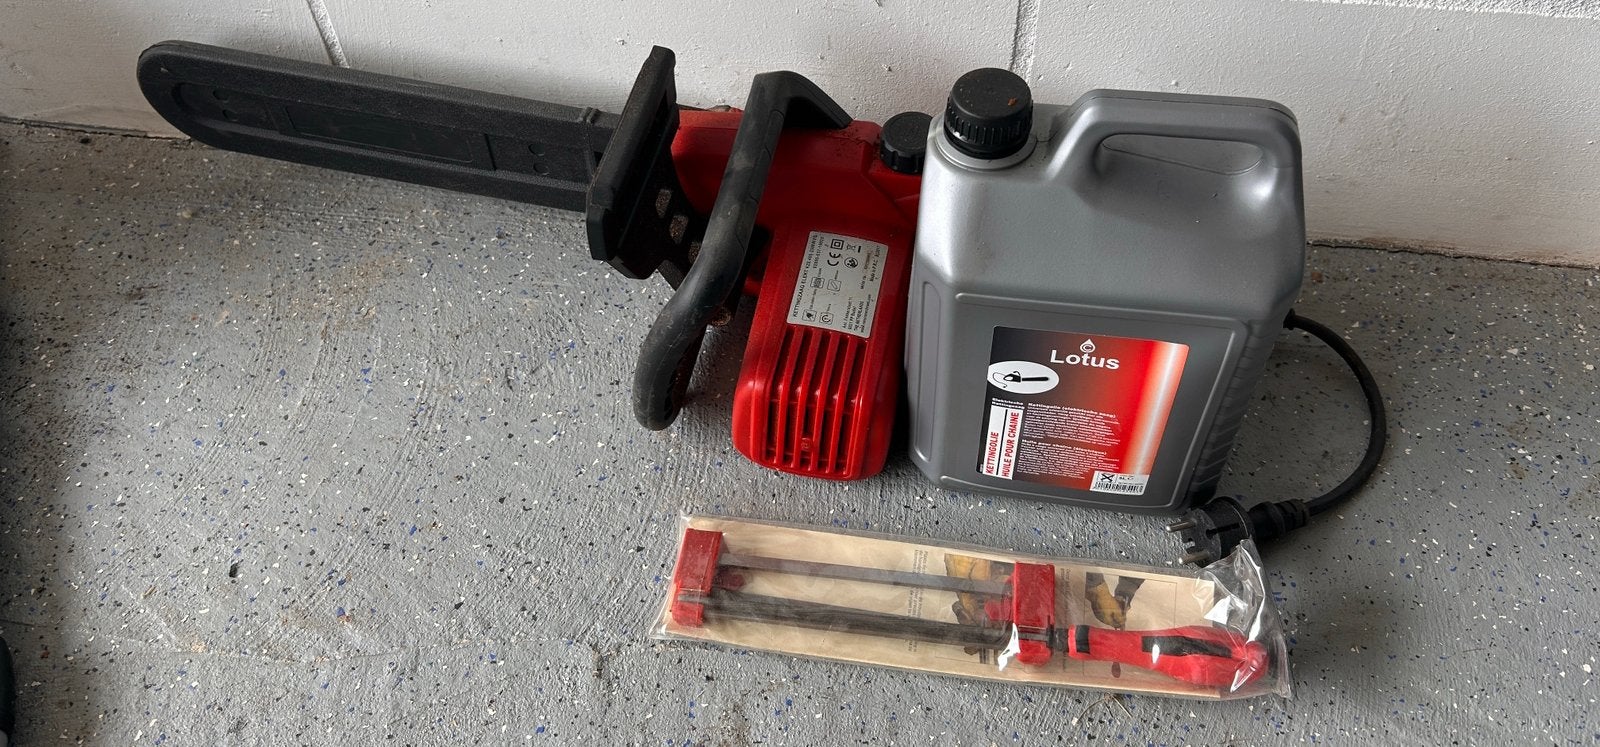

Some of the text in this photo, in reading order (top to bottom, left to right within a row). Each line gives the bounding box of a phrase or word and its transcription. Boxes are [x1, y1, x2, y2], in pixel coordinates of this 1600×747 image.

[1050, 349, 1120, 370] Lotus
[986, 432, 999, 475] KETTINGOLIE
[1002, 412, 1020, 478] HUILE POUR CHAINE
